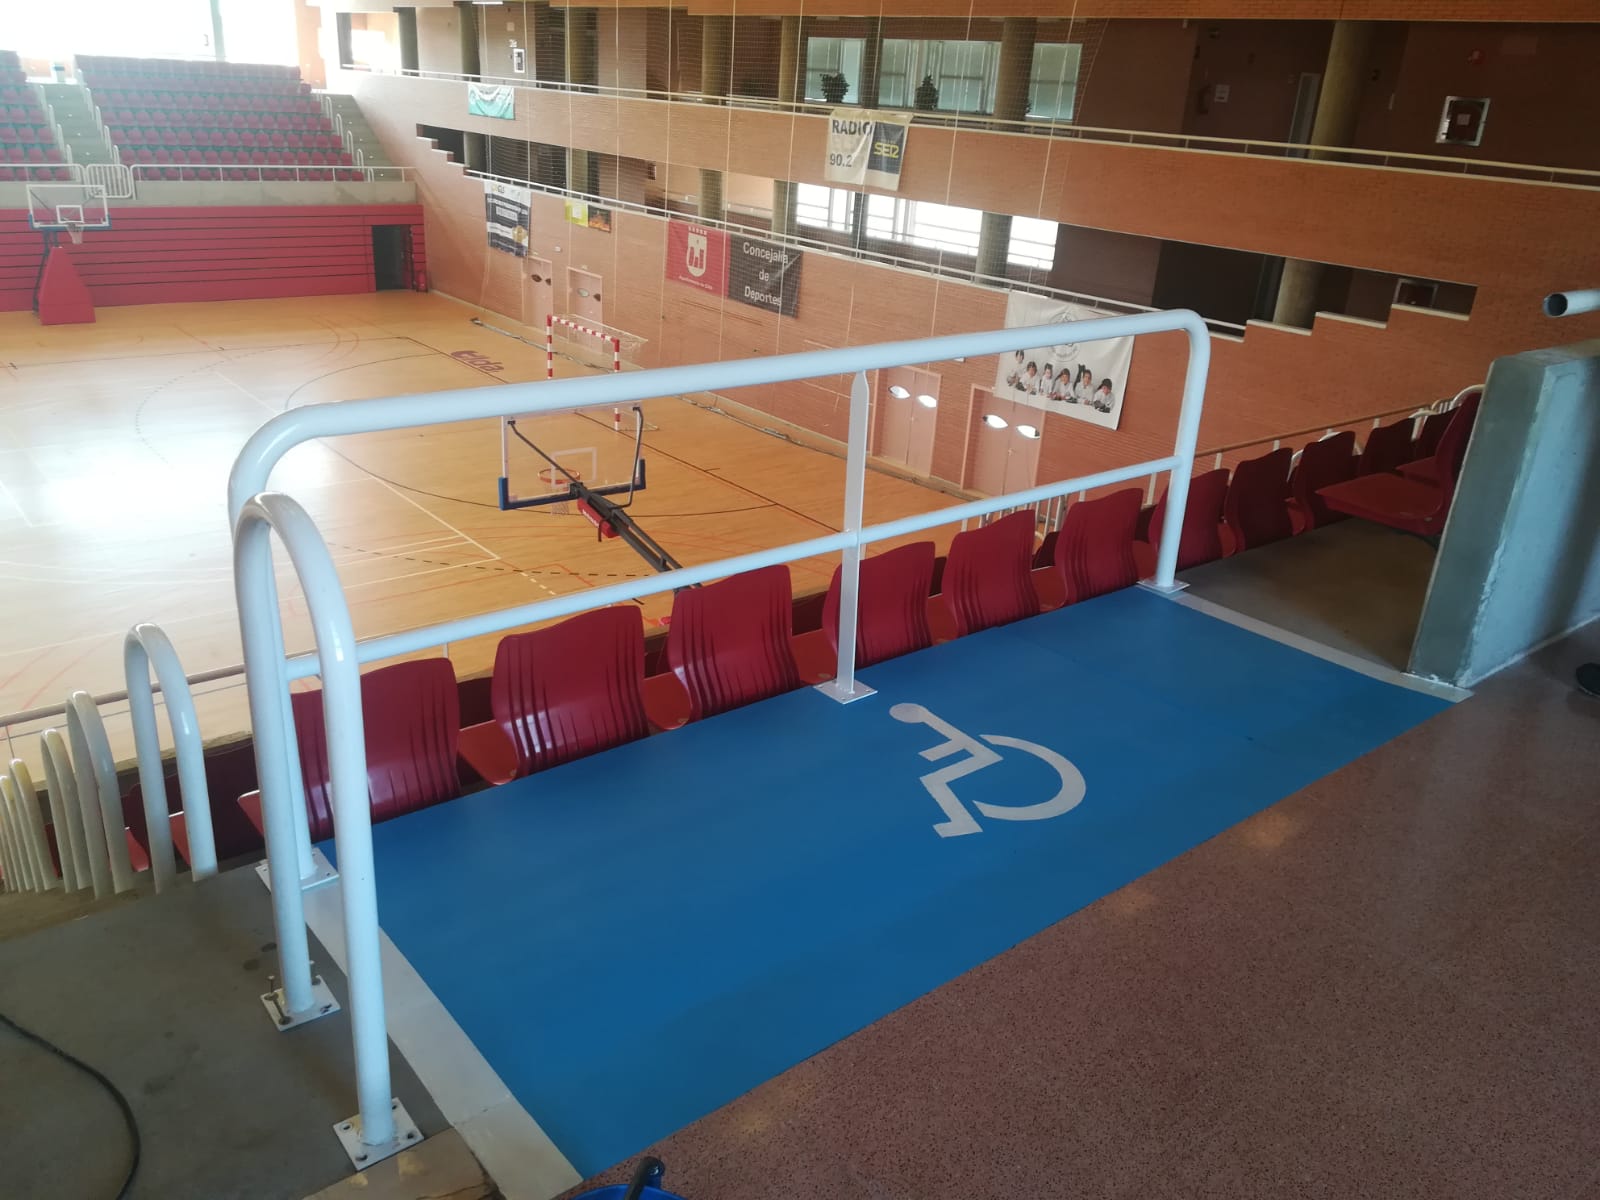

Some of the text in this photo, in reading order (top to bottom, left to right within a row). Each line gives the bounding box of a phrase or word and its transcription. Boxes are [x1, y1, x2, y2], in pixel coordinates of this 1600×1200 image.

[832, 119, 873, 136] RADIO
[830, 153, 853, 168] 90.2
[758, 269, 770, 281] de
[744, 286, 782, 306] Deportes
